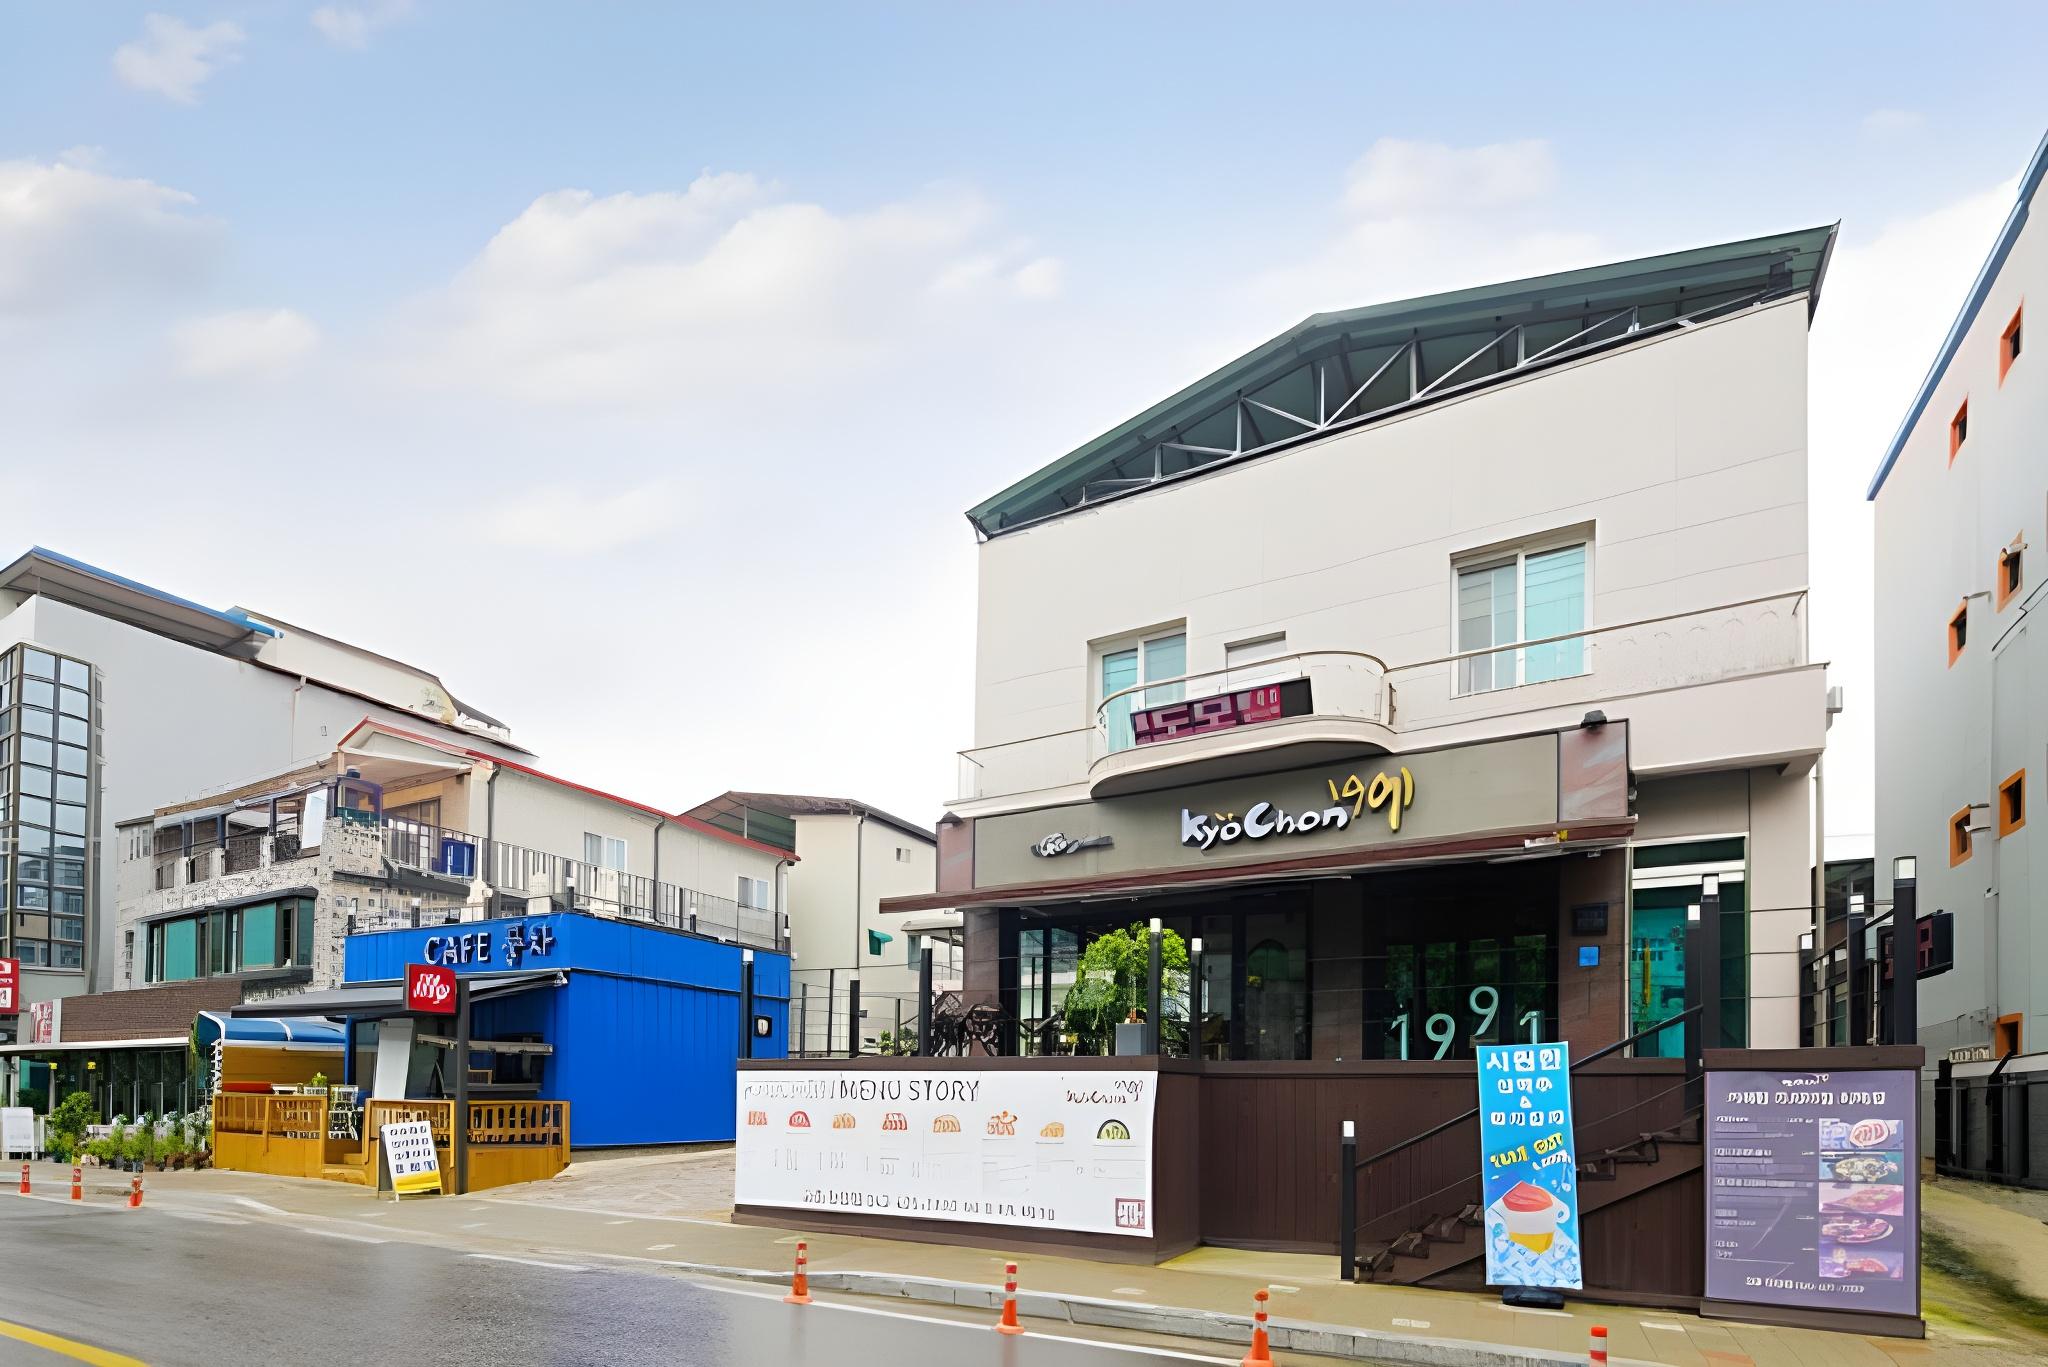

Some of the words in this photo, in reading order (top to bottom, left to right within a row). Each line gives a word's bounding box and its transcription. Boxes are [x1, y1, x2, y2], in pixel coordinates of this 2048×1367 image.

[1328, 767, 1414, 832] 1991
[424, 932, 490, 965] CAFE
[1390, 985, 1542, 1061] 1991
[909, 1079, 980, 1102] STORY
